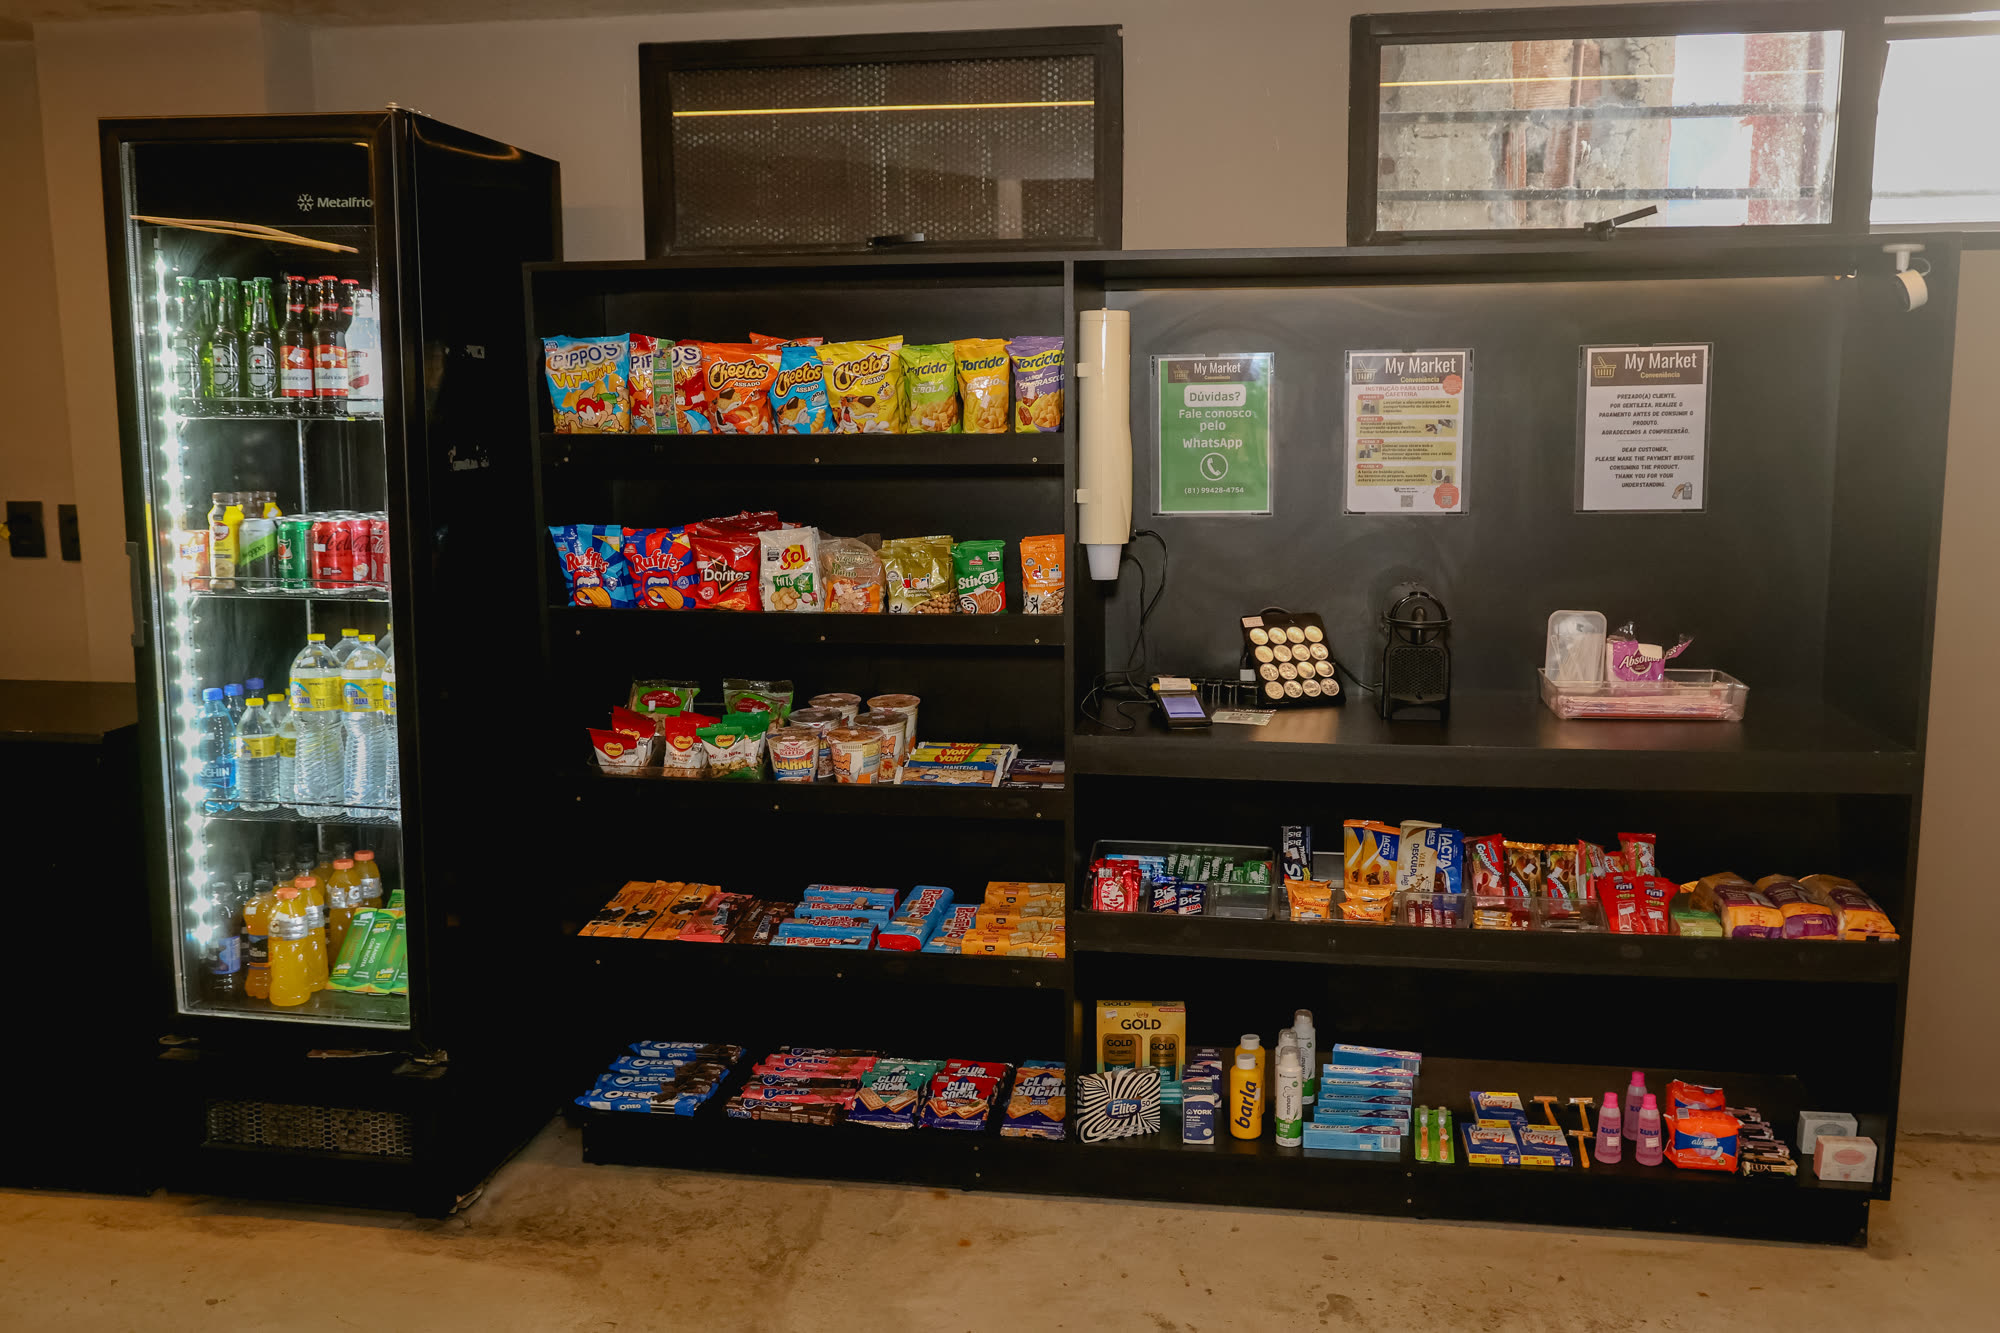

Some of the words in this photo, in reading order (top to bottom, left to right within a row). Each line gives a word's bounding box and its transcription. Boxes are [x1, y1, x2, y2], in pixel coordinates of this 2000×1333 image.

[317, 196, 374, 208] Metalfrio
[960, 355, 1005, 371] Torcida
[1017, 352, 1061, 370] Torcida
[1385, 358, 1405, 376] My
[1409, 357, 1456, 374] Market
[1624, 354, 1644, 371] My
[1649, 352, 1697, 369] Market
[709, 359, 769, 390] Cheetos
[832, 352, 890, 392] Cheetos
[1194, 362, 1206, 376] My
[1209, 362, 1241, 374] Market
[734, 380, 760, 388] ASSADO
[773, 361, 823, 397] Cheetos
[1189, 391, 1241, 402] Dúvidas?
[1178, 409, 1202, 419] Fale
[1205, 410, 1252, 418] conosco
[1200, 420, 1226, 432] pelo
[1182, 438, 1243, 450] WhatsApp
[565, 547, 610, 574] Ruffles
[631, 548, 684, 574] Ruffles
[703, 567, 751, 583] Doritos
[958, 569, 998, 590] Stiksy
[776, 576, 794, 587] HITS
[1382, 835, 1391, 856] LACTA
[1439, 834, 1453, 870] LACTA
[1410, 843, 1420, 877] DESCULPA
[349, 886, 360, 899] G
[1121, 1019, 1161, 1030] GOLD
[632, 1059, 683, 1067] OREO
[958, 1067, 986, 1075] CLUB
[616, 1075, 675, 1084] OREO
[878, 1075, 906, 1083] CLUB
[1022, 1076, 1062, 1087] CLUB
[872, 1082, 909, 1090] SOCIAL
[947, 1081, 976, 1091] CLUB
[1014, 1086, 1066, 1097] SOCIAL
[604, 1090, 658, 1099] OREO
[941, 1090, 978, 1100] SOCIAL
[1111, 1104, 1137, 1116] Elite
[1234, 1080, 1256, 1130] barla
[1600, 1126, 1620, 1134] ZULU
[1640, 1127, 1659, 1136] ZULU
[1752, 1164, 1770, 1172] LUX
